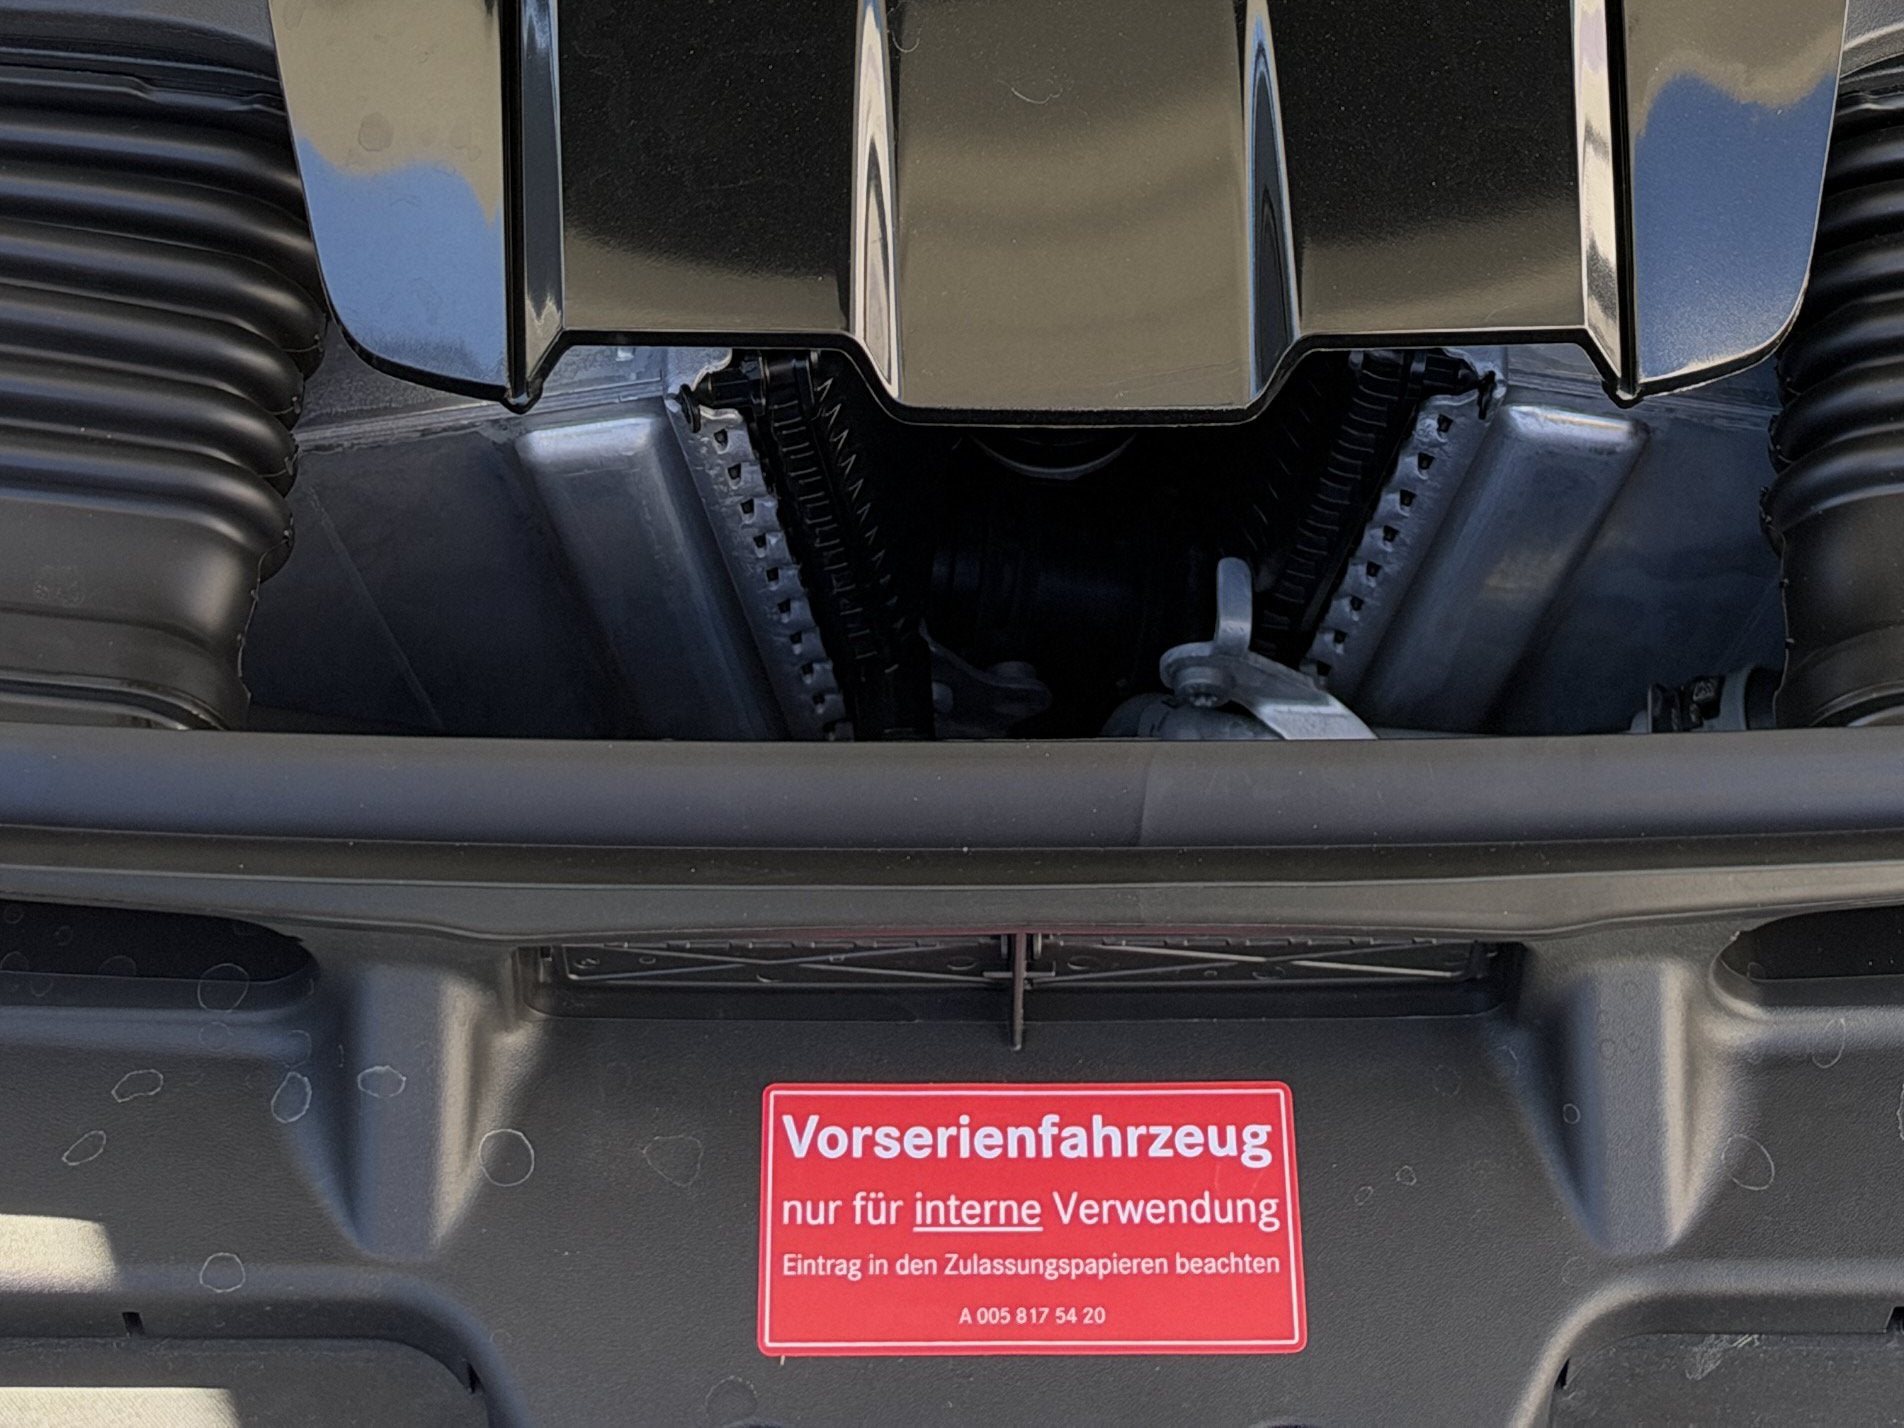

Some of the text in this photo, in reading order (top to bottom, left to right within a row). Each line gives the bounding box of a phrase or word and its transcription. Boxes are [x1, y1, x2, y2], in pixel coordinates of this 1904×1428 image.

[782, 1113, 1273, 1169] Vorserienfahrzeug
[782, 1191, 1281, 1232] nur für interne Verwendung
[782, 1252, 1281, 1282] Eintrag in den Zulassungspapieren beachten
[958, 1306, 1106, 1325] A 005 817 54 20
